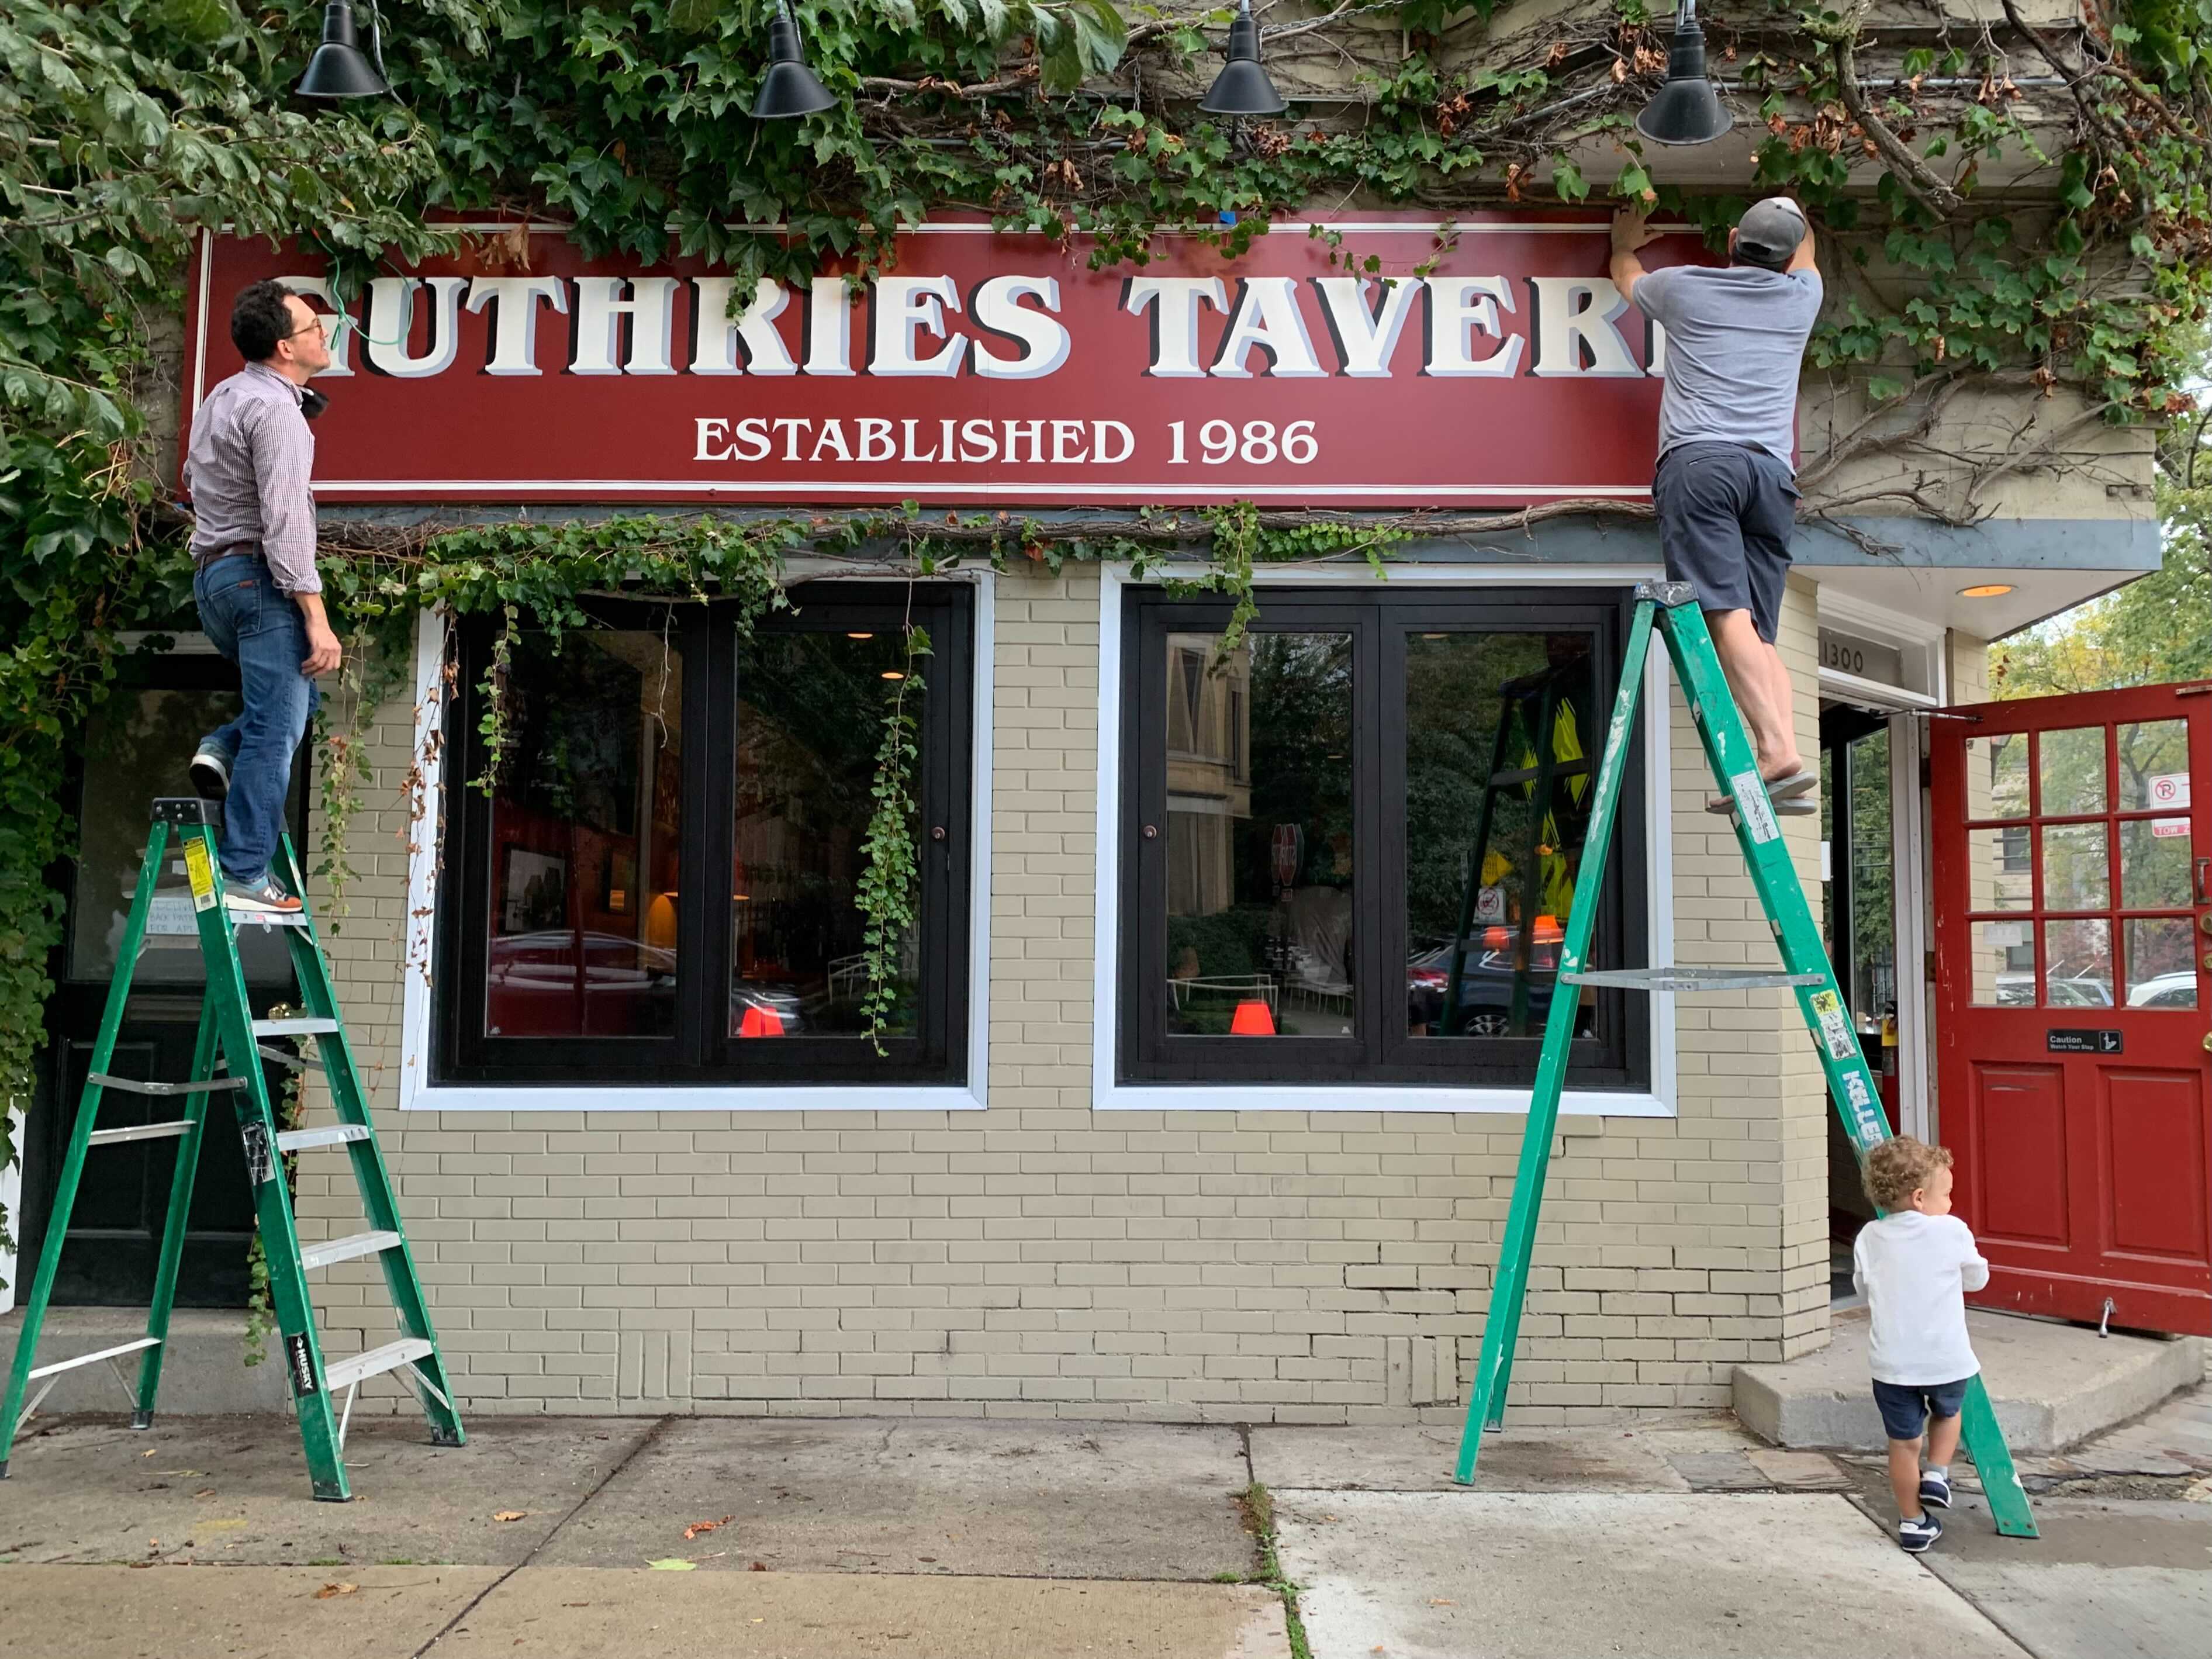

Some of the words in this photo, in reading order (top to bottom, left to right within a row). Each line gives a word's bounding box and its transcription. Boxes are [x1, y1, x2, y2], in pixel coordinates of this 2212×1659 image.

[1126, 275, 1666, 378] TAVER
[692, 417, 1135, 464] ESTABLISHED
[1167, 419, 1319, 465] 1986
[1824, 641, 1863, 672] 1300
[2158, 826, 2178, 835] TOW
[2049, 1035, 2082, 1043] Caution
[298, 1348, 313, 1389] HUSKY
